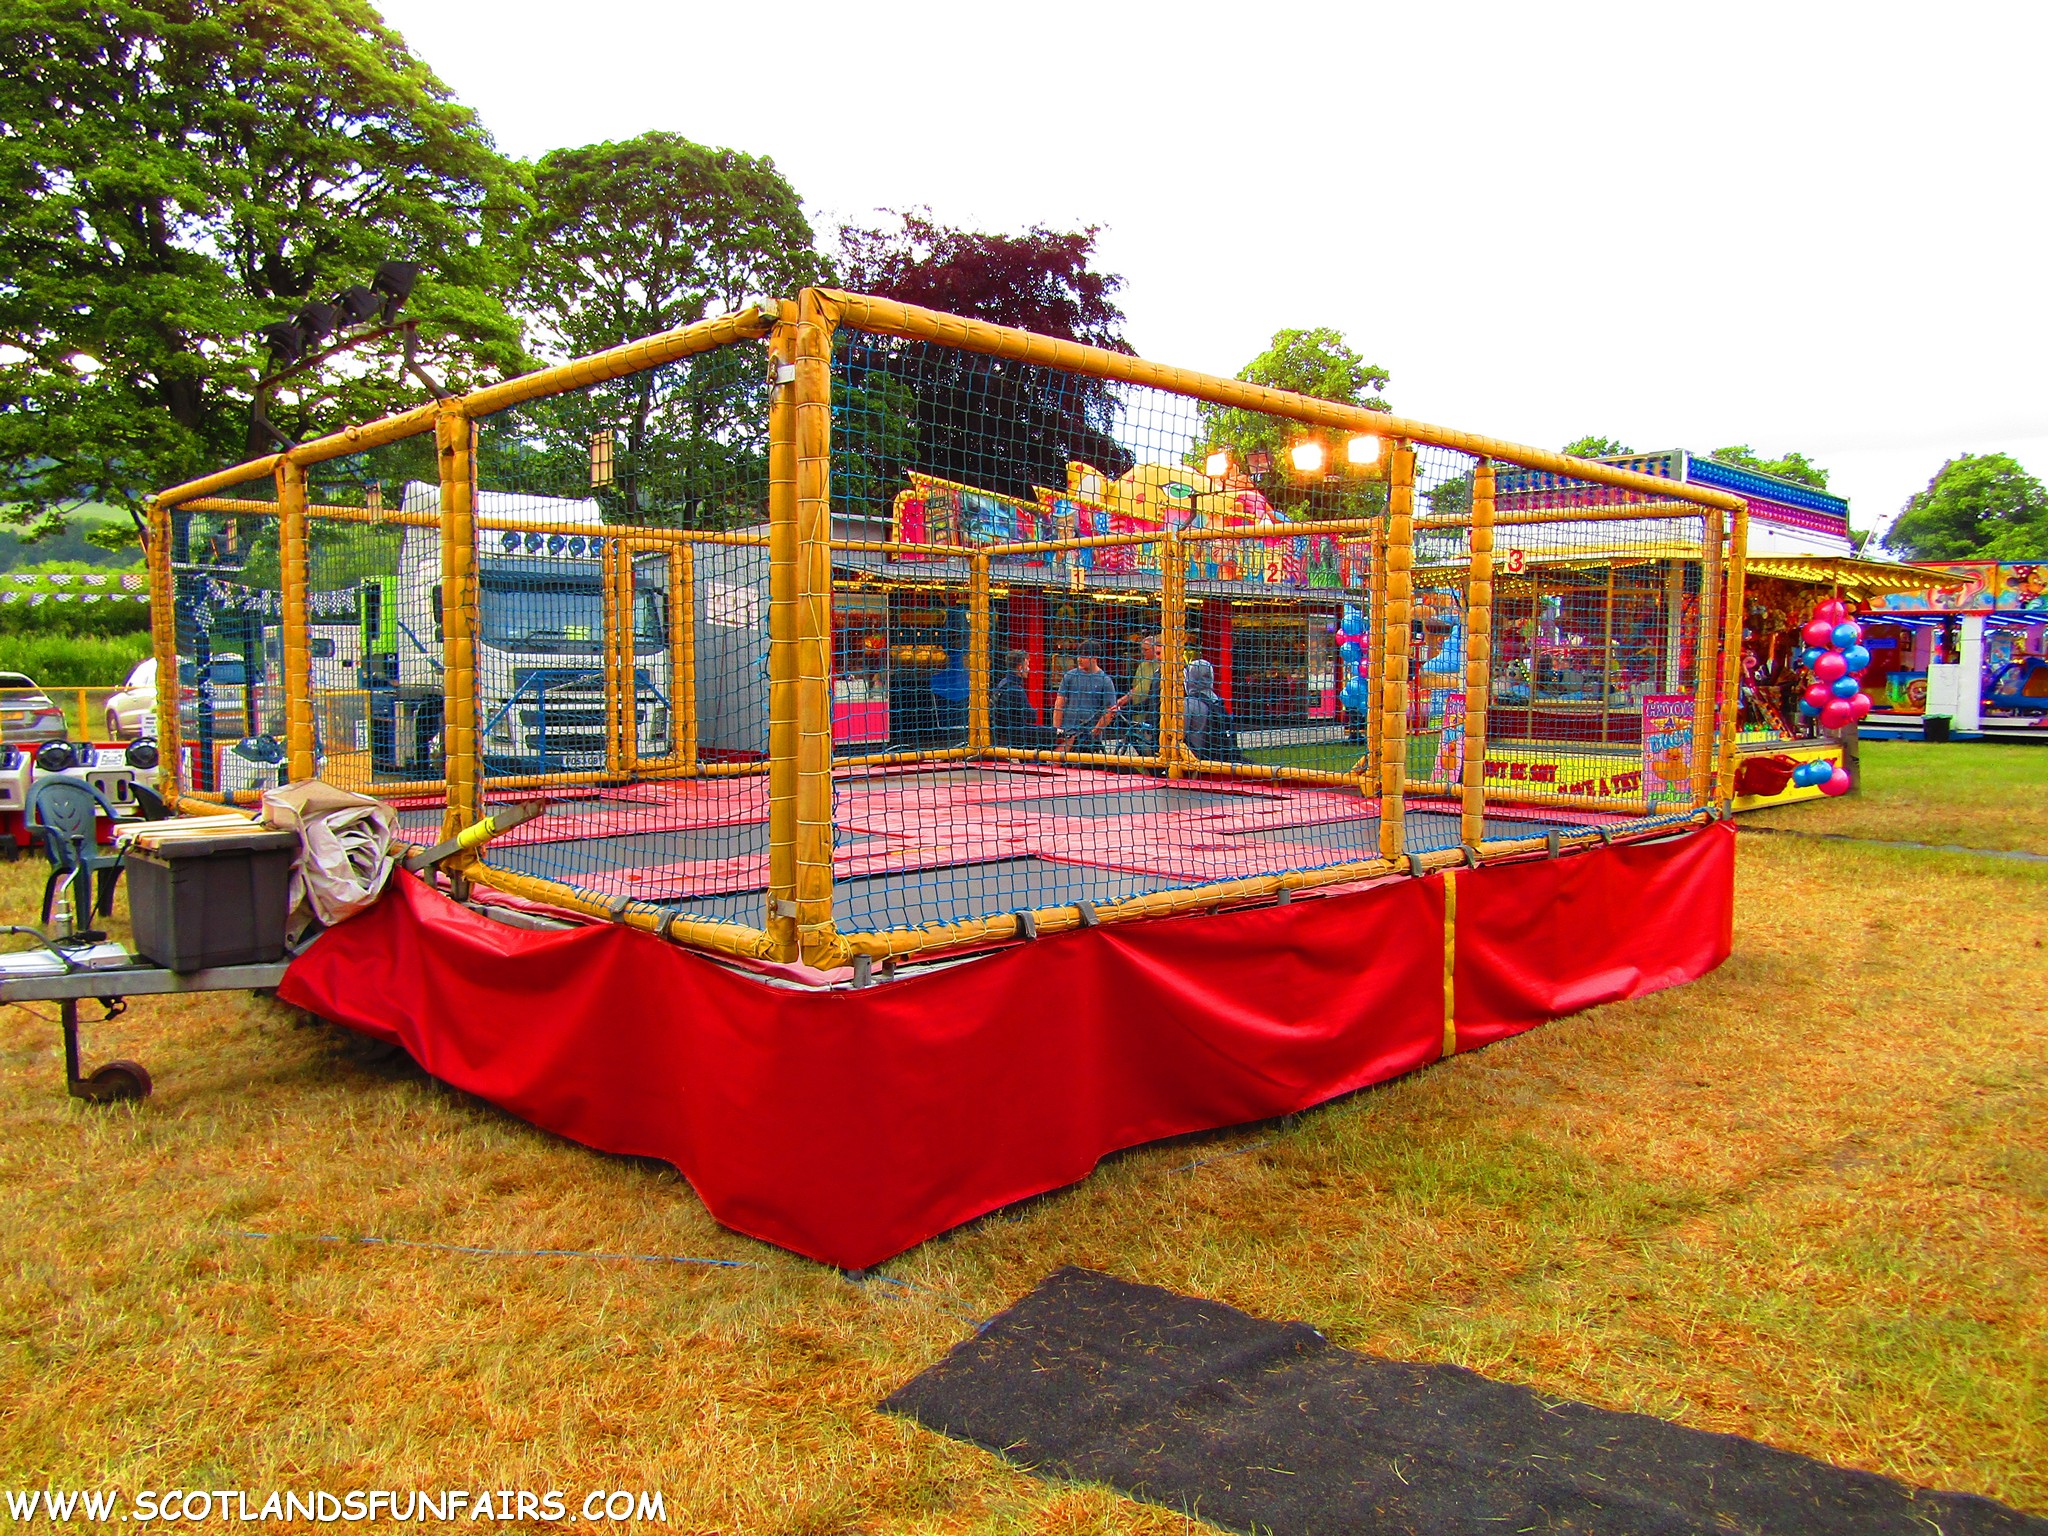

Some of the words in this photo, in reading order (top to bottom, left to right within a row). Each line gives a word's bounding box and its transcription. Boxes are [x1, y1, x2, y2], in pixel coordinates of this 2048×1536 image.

[1508, 550, 1523, 572] 3
[1267, 563, 1278, 583] 2
[1646, 701, 1694, 717] HOOK
[1663, 716, 1676, 729] A
[1647, 728, 1693, 753] DUCK
